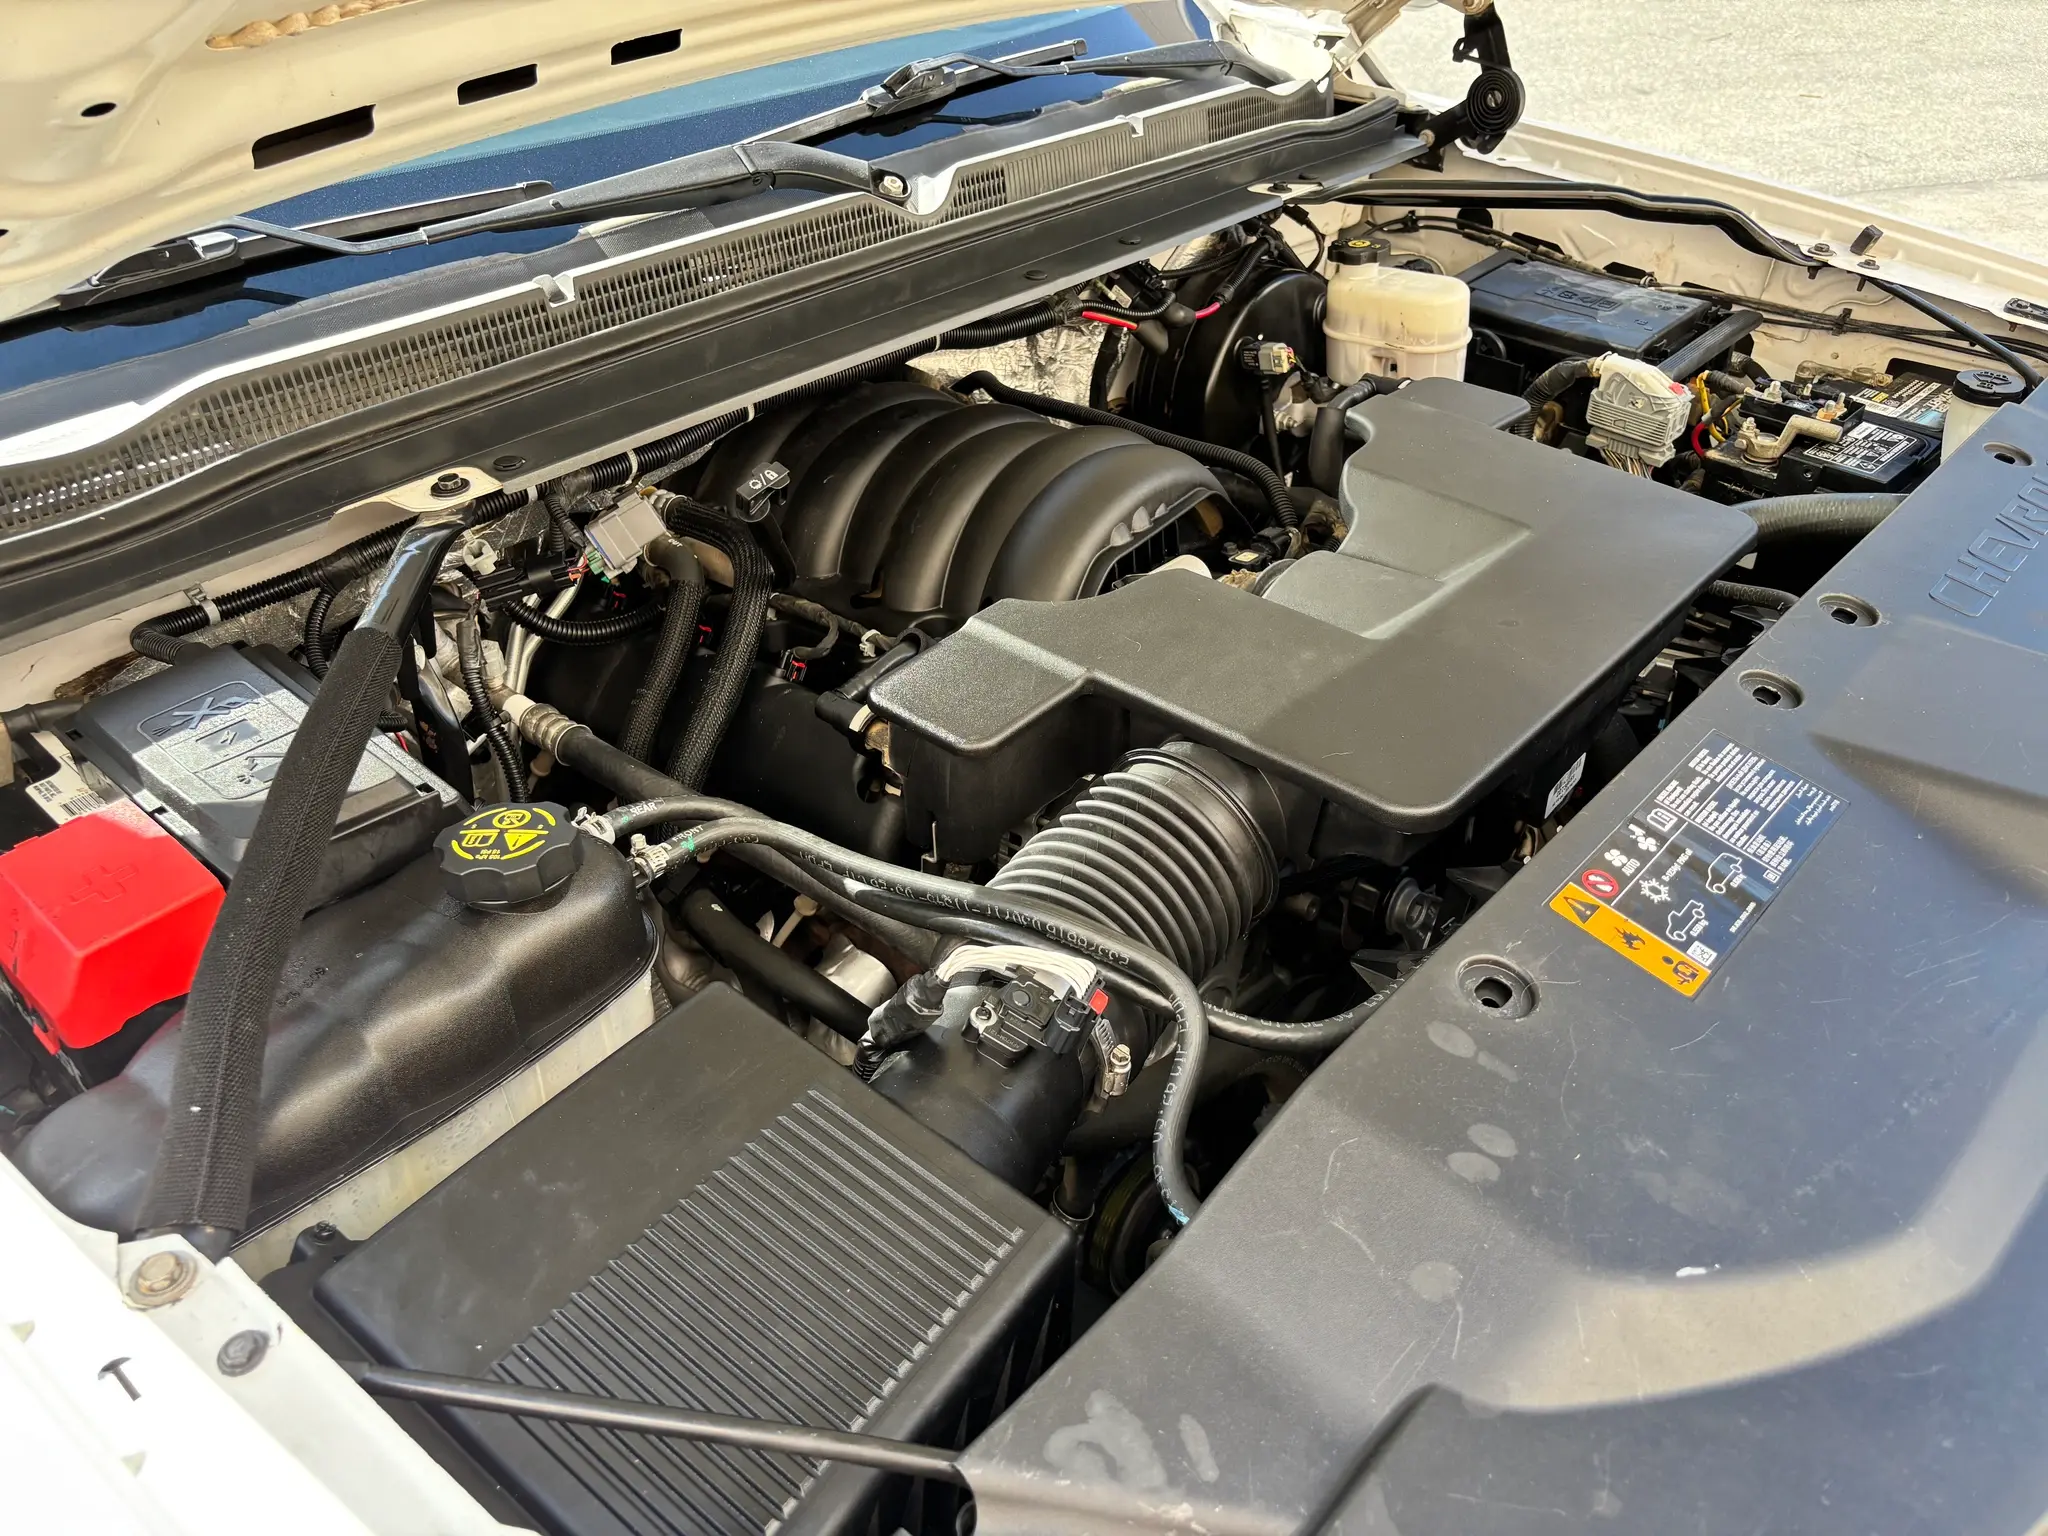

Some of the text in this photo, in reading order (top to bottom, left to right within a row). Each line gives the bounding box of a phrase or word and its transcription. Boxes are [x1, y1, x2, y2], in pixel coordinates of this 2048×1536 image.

[630, 802, 657, 817] REAR
[672, 824, 704, 843] FRONT
[1619, 857, 1641, 876] AUTO
